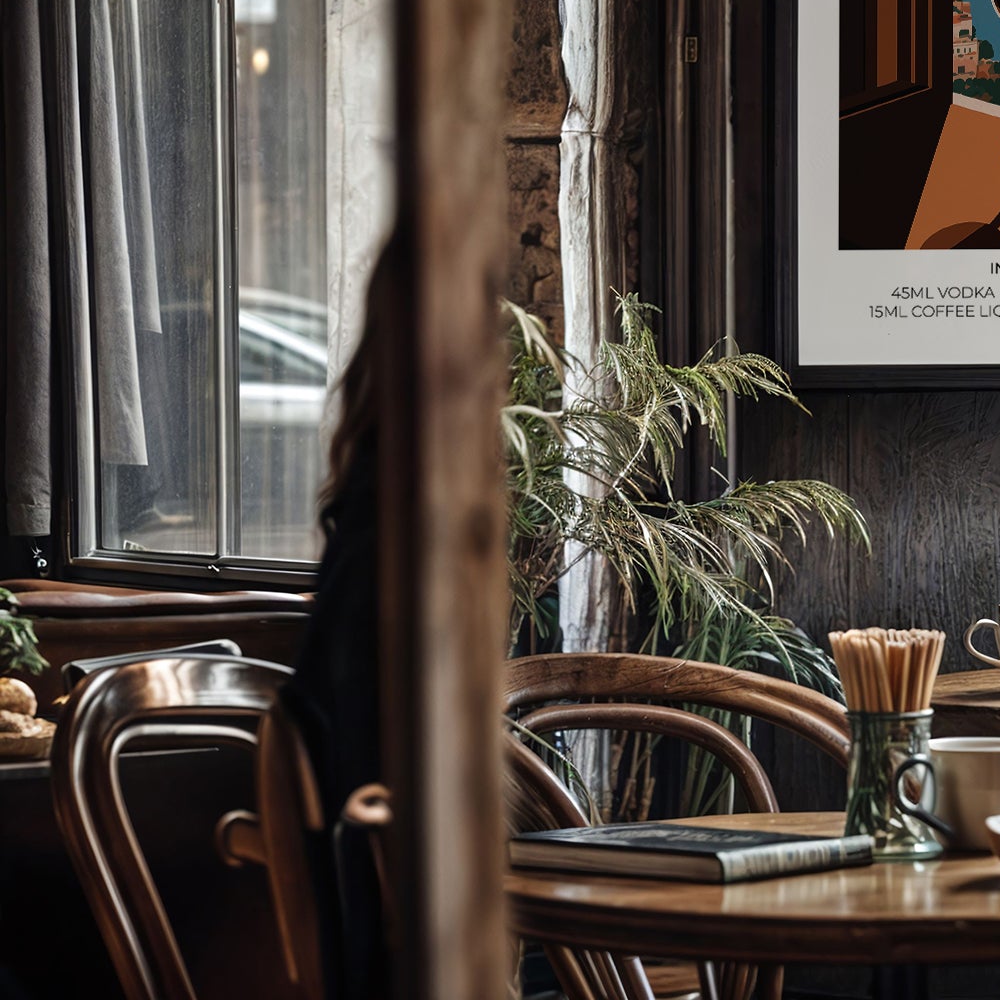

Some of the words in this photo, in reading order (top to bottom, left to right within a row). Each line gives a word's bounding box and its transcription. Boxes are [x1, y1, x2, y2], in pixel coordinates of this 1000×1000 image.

[891, 286, 934, 300] 45ML
[937, 286, 996, 300] VODKA
[869, 304, 908, 319] 15ML
[911, 304, 976, 318] COFFEE
